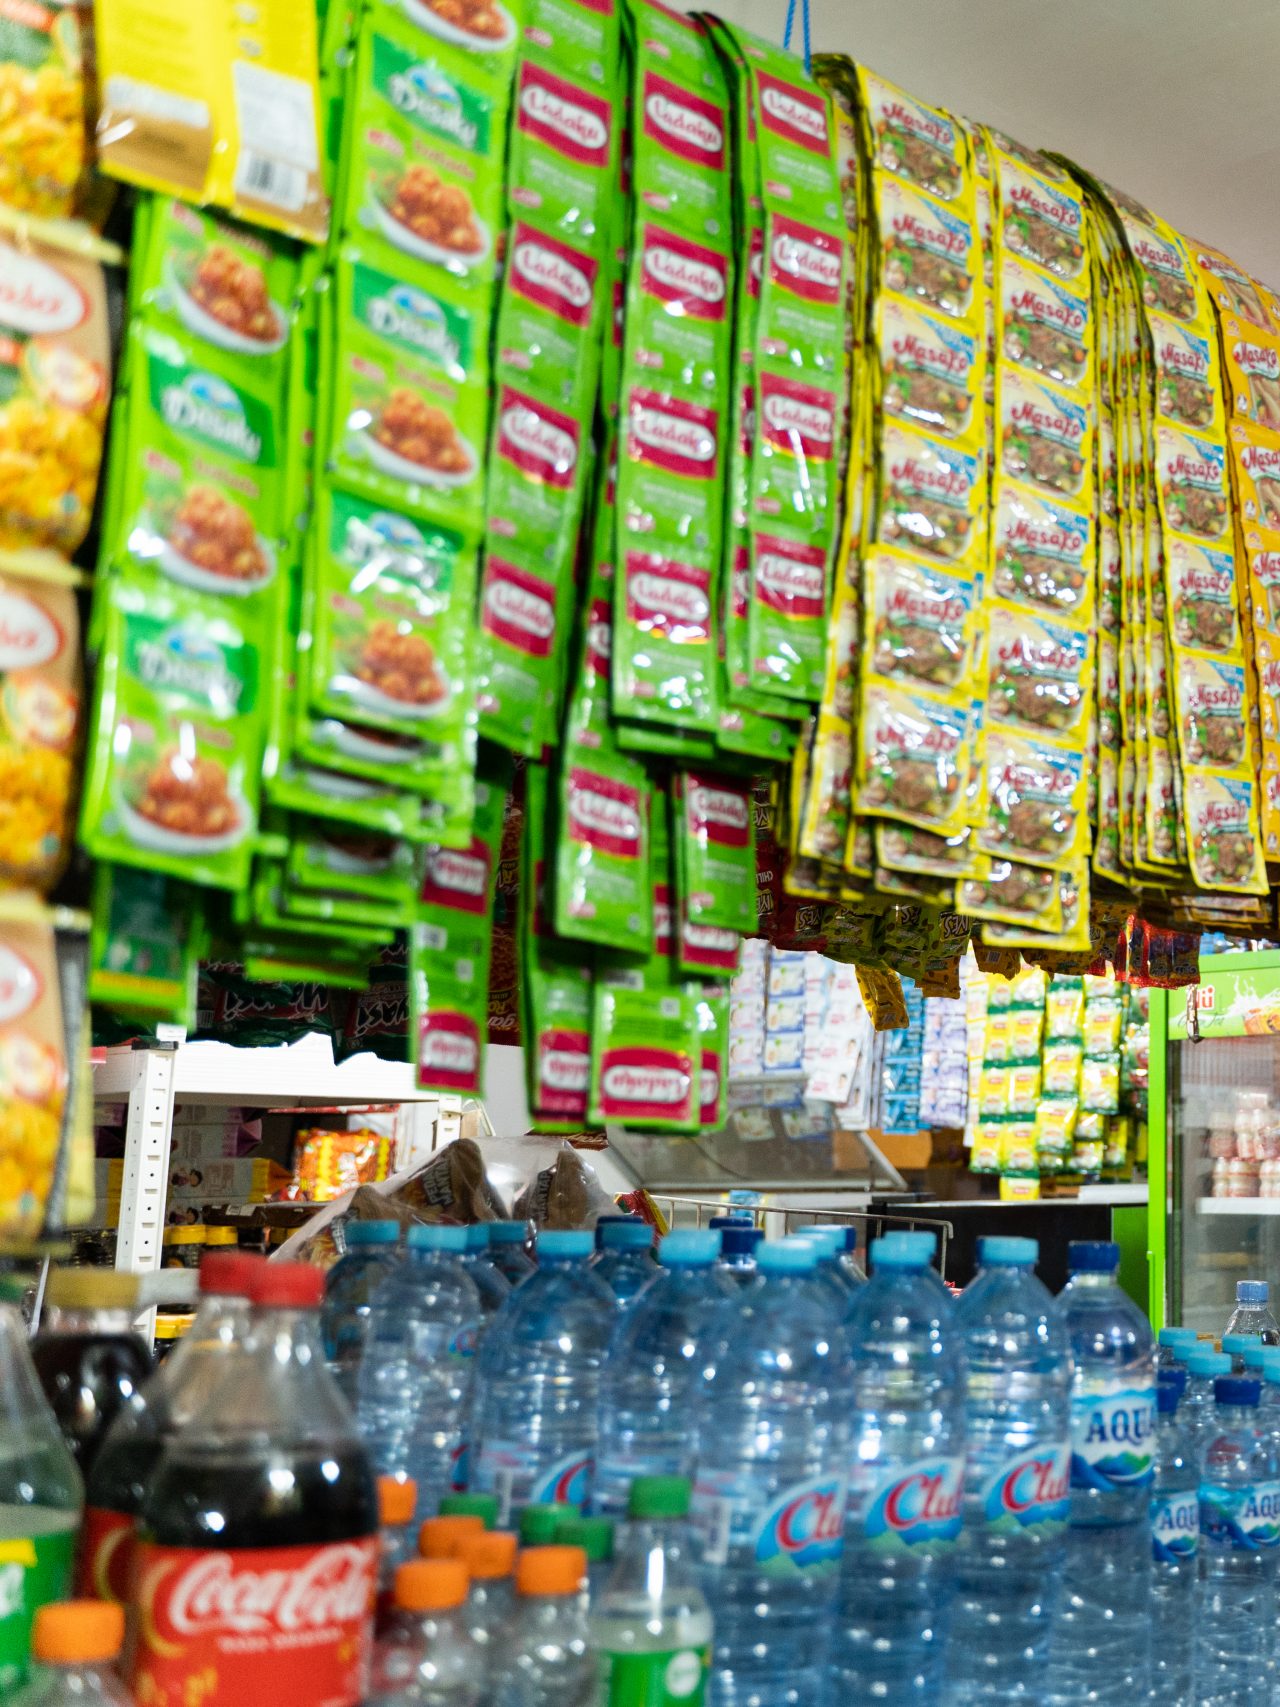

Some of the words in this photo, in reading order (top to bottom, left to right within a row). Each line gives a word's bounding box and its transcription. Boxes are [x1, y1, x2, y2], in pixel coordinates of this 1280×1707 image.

[883, 103, 950, 143] Masako
[1010, 187, 1077, 226] Masako
[894, 214, 966, 252] Masako
[1012, 291, 1081, 327] Masako
[893, 335, 966, 372] Masako
[1235, 343, 1277, 369] Masako
[1012, 402, 1081, 437] Masako
[892, 458, 967, 495] Masako
[1168, 456, 1219, 479] Masako
[1008, 523, 1081, 551] Masako
[1180, 569, 1230, 592] Masako
[1159, 1506, 1198, 1530] AQU
